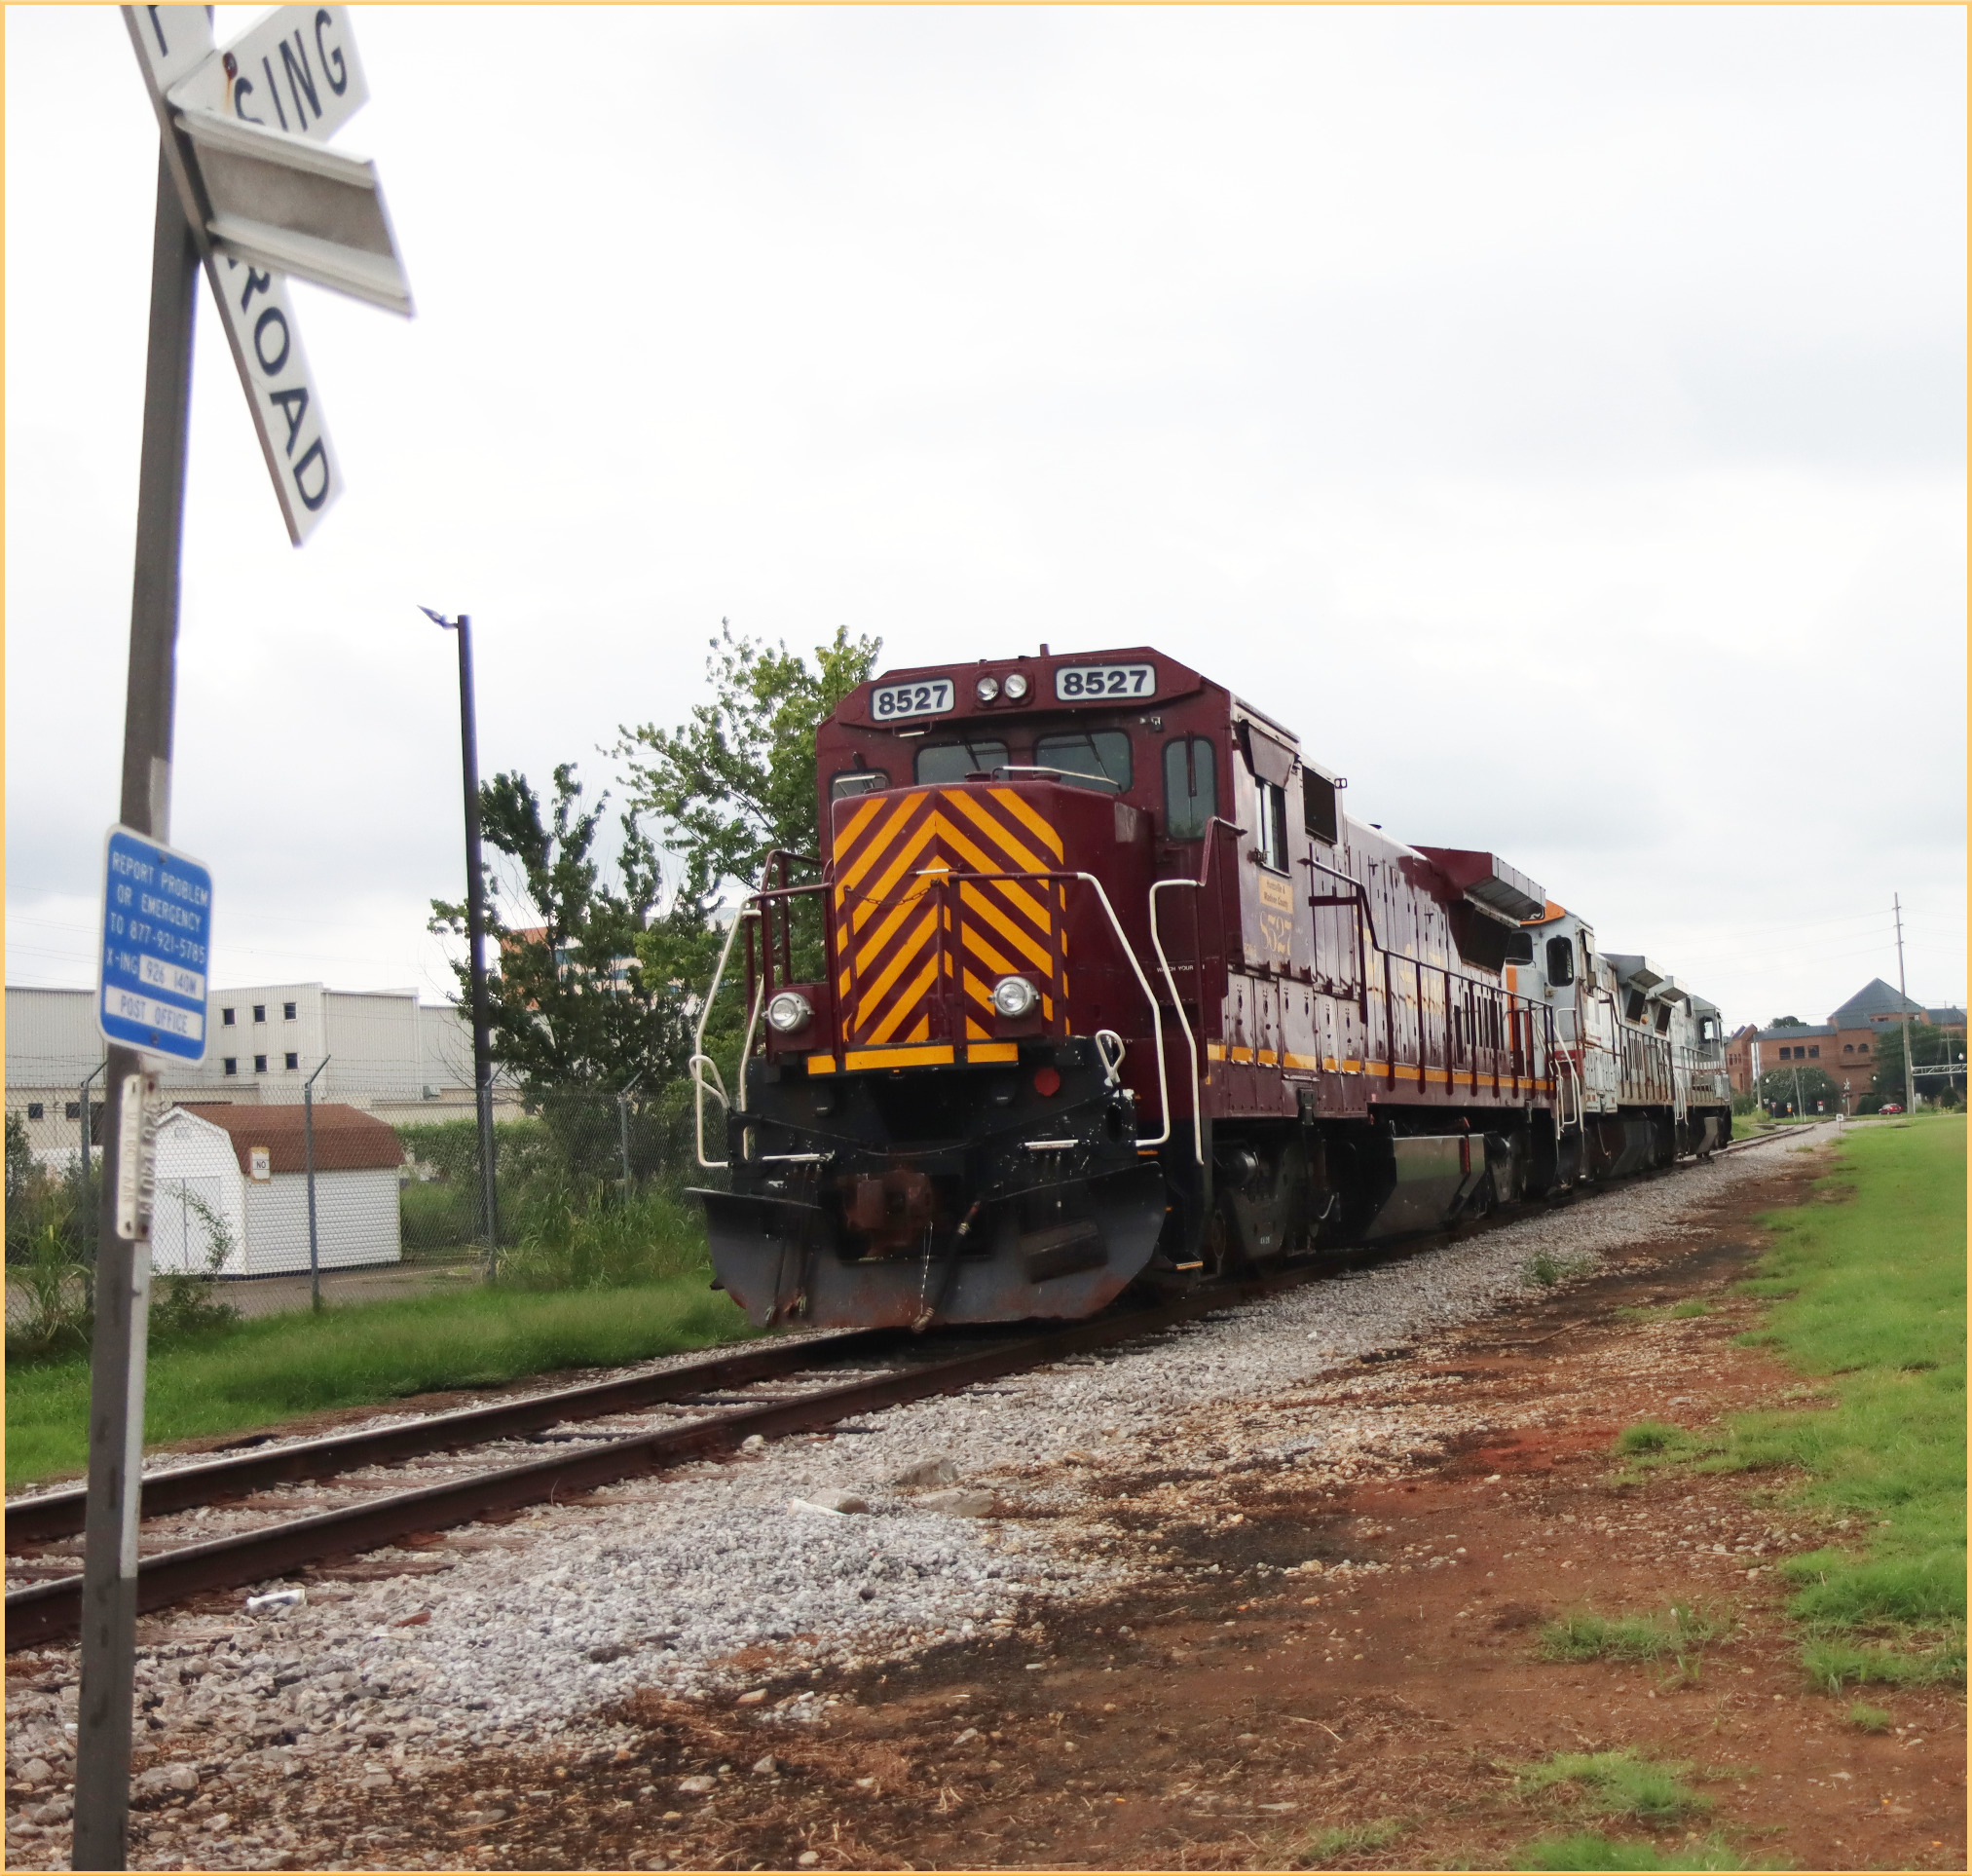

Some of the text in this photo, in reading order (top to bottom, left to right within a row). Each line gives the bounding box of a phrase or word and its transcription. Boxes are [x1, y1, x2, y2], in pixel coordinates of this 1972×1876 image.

[878, 685, 949, 716] 8527
[1063, 670, 1147, 696] 8527
[112, 851, 208, 907] REPORT PROBLEM
[118, 883, 202, 932] OR EMERGENCY
[111, 912, 205, 964] TO 877-921-5785
[106, 947, 139, 975] X-ING
[147, 960, 165, 985] 926
[120, 994, 189, 1034] POST OFFICE
[256, 1160, 267, 1169] NO
